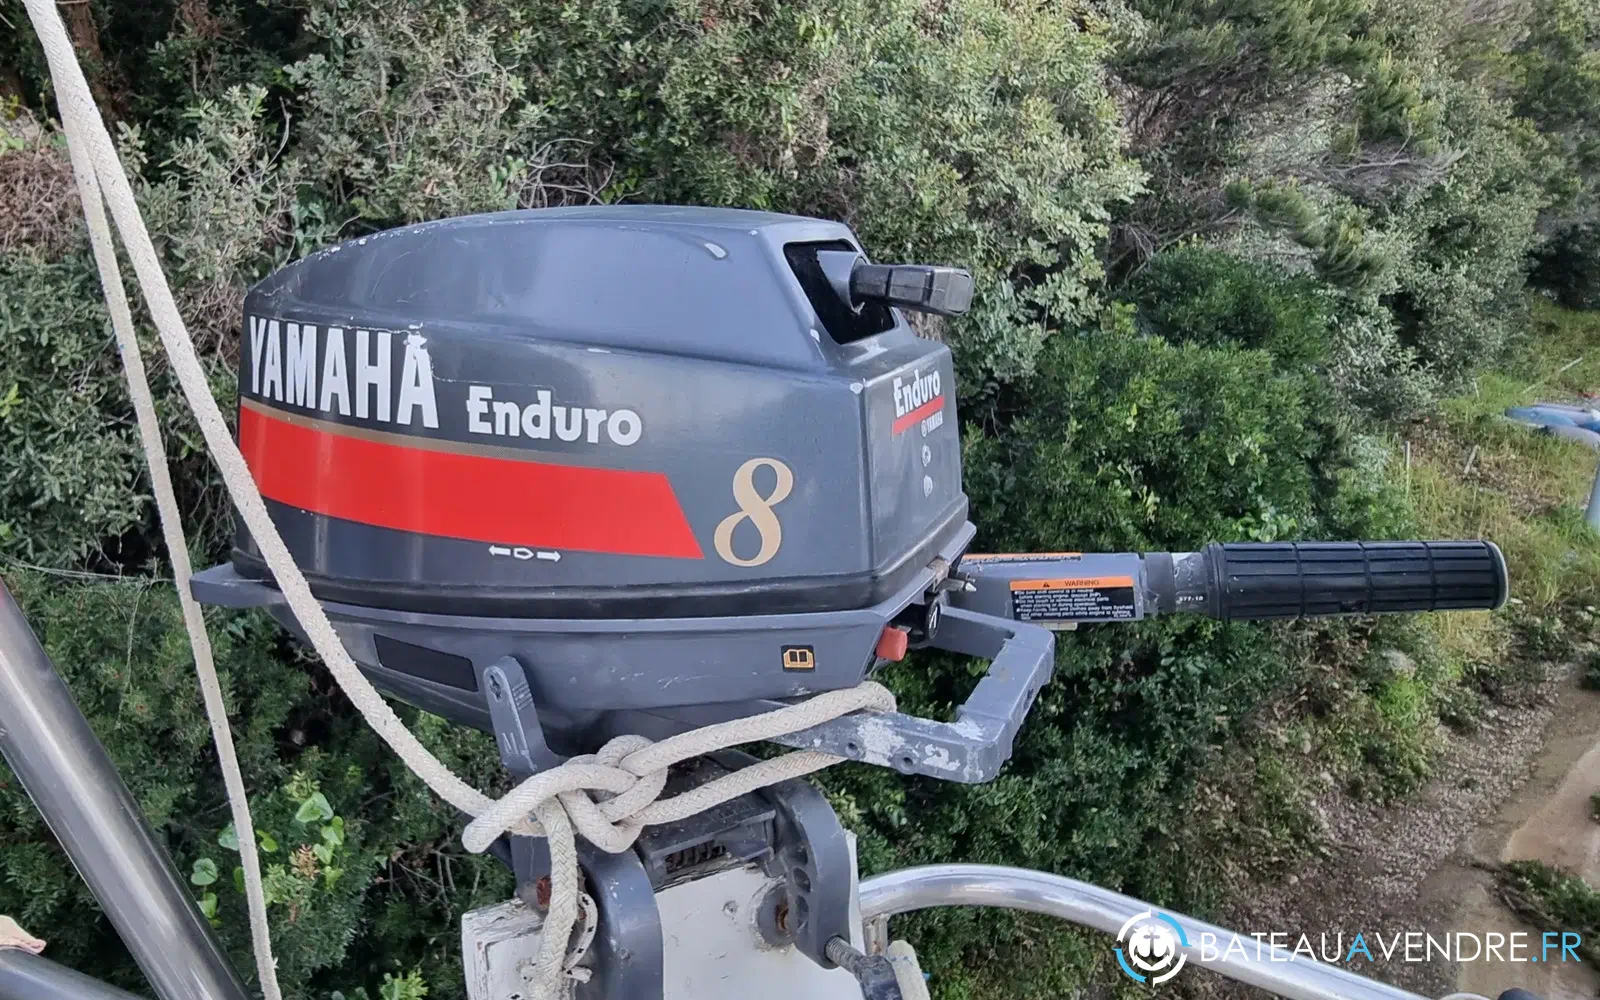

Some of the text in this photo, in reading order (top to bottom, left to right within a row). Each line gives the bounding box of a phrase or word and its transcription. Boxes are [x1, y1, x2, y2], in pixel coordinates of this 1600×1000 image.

[249, 315, 643, 446] YAMAHA Enduro
[893, 369, 941, 418] Enduro
[714, 457, 794, 567] 8
